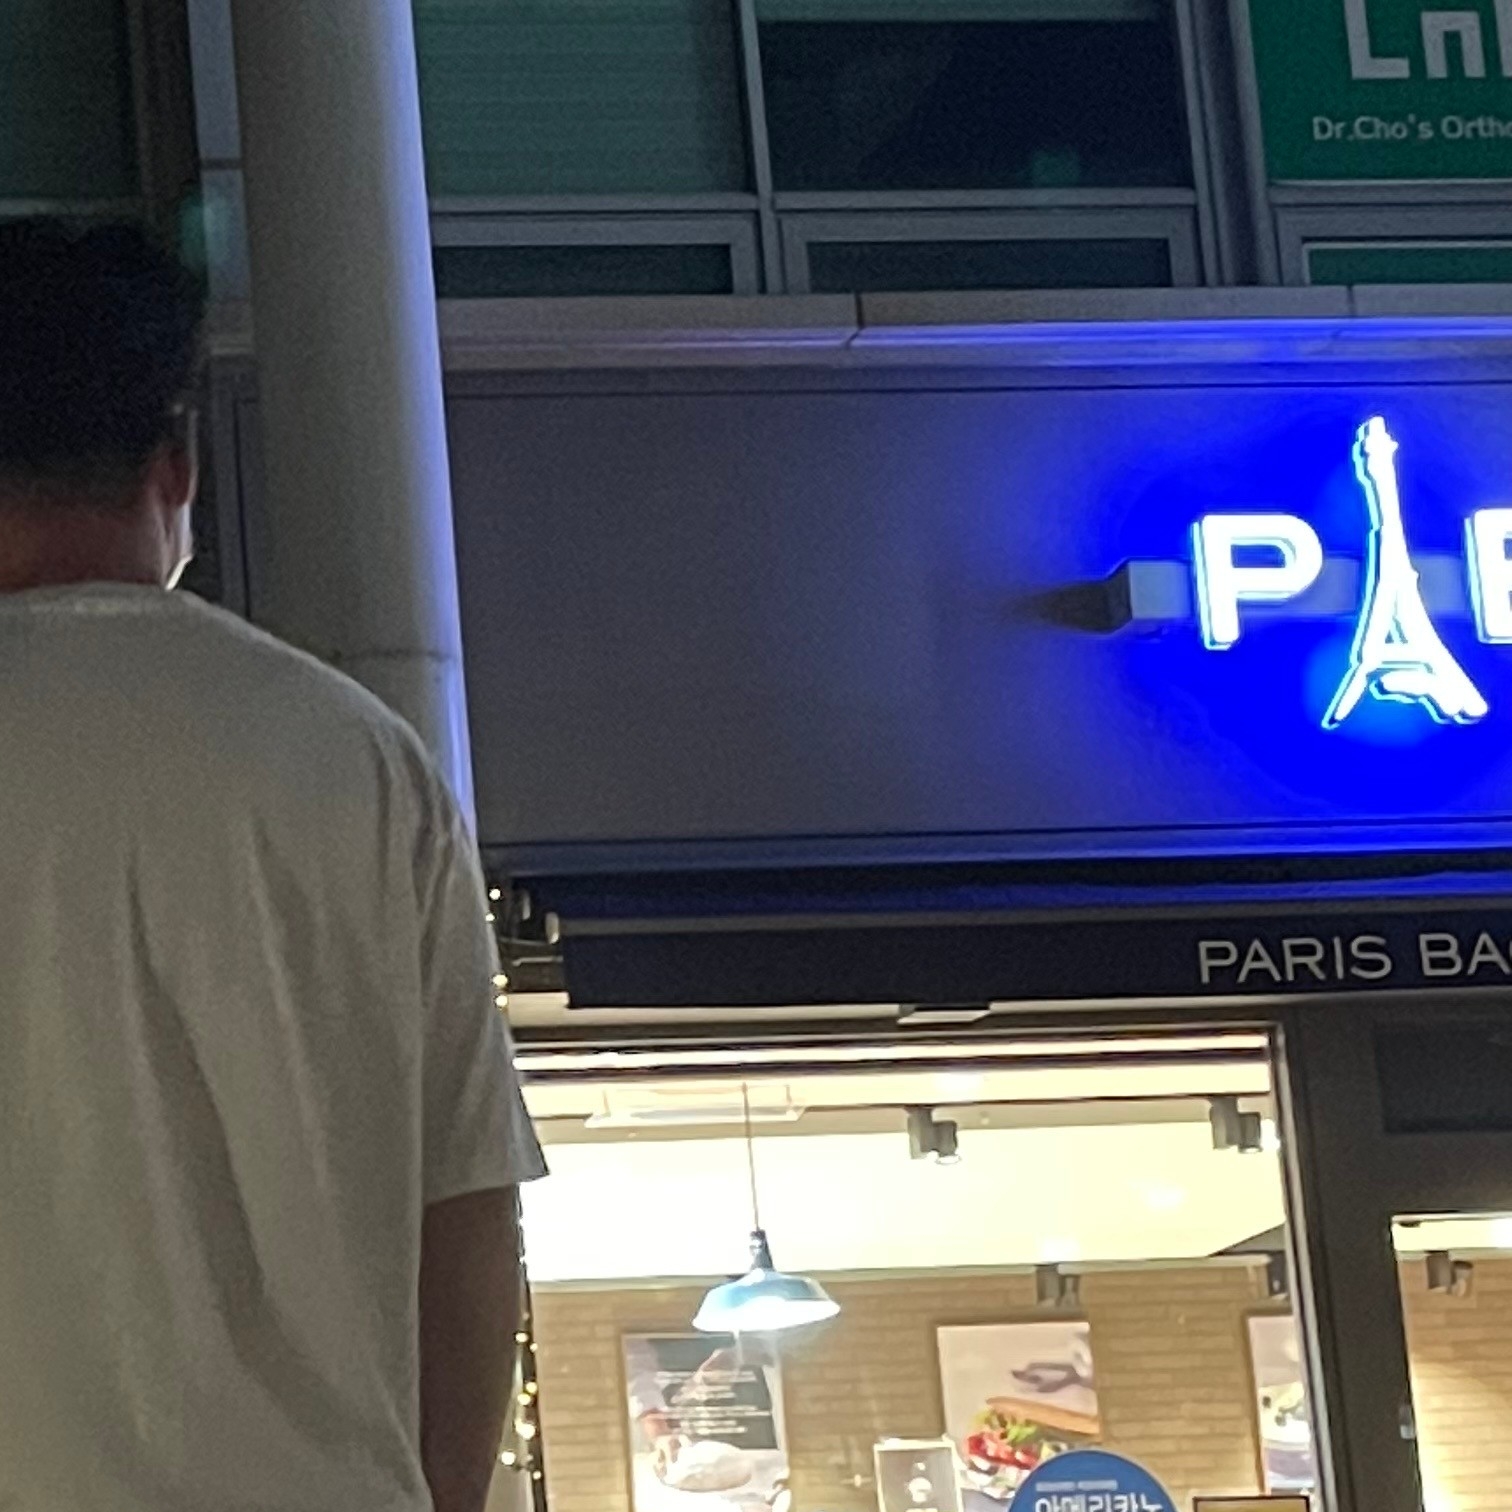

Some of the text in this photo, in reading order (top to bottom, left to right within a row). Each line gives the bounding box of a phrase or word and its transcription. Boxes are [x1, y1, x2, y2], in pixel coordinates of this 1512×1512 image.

[1312, 114, 1434, 141] Dr.Cho's
[1198, 931, 1512, 985] PARIS BA
